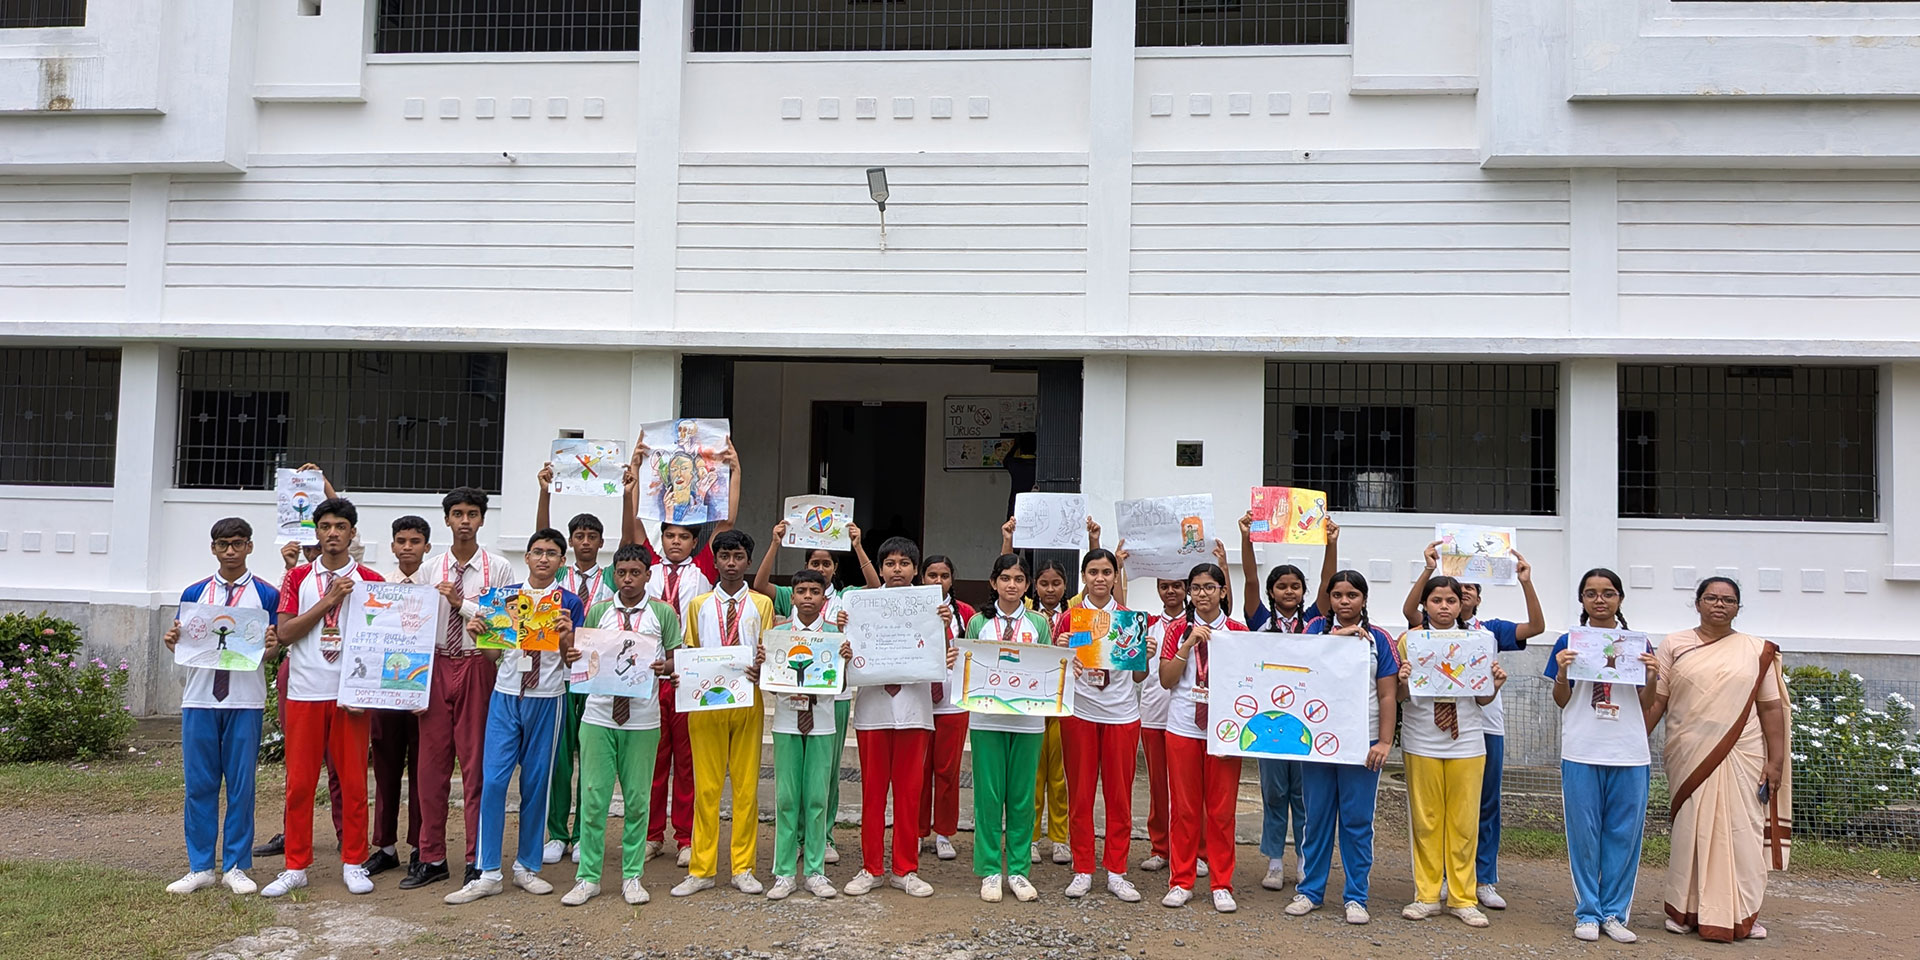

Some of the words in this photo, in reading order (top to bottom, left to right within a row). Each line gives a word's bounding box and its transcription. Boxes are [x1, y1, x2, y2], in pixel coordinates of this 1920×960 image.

[950, 404, 964, 413] SAY
[967, 404, 977, 413] NO
[950, 416, 962, 426] TO
[953, 426, 981, 436] DRUGS
[1121, 501, 1165, 516] DRUG
[376, 592, 404, 601] INDIA
[863, 598, 879, 608] THE
[881, 605, 918, 619] DRUGS
